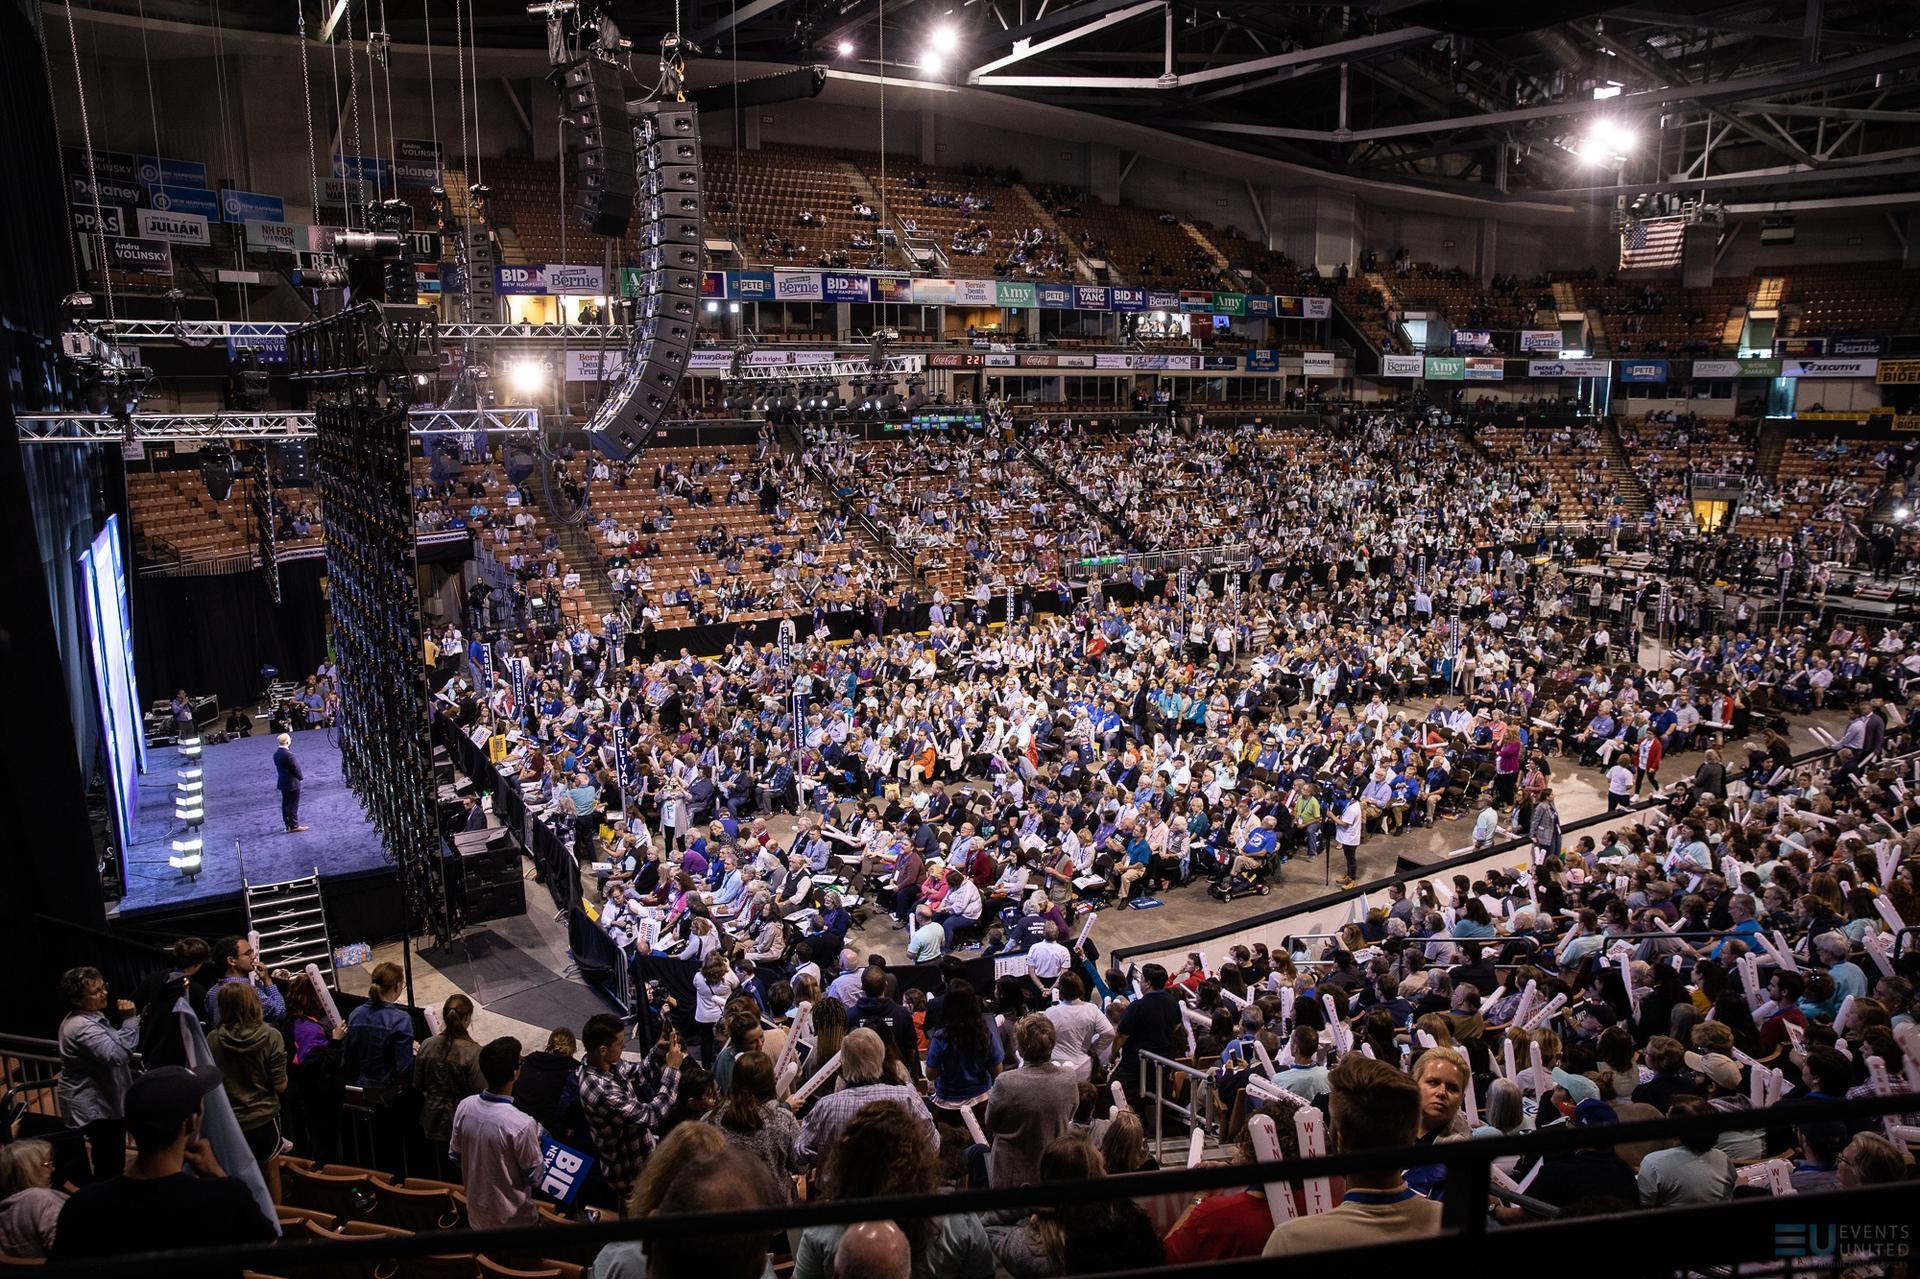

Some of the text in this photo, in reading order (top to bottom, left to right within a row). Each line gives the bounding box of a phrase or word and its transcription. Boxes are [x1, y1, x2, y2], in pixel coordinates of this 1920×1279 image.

[402, 149, 441, 158] VOLINSKY
[150, 221, 200, 236] JULIÁN
[262, 225, 294, 237] NH FOR
[115, 242, 140, 250] Andru
[116, 250, 168, 261] VOLINSKY
[551, 275, 600, 288] Bernie
[742, 281, 764, 291] PETE
[778, 280, 819, 294] Bernie
[827, 278, 864, 290] BIDEN
[1000, 286, 1031, 302] Amy
[1046, 292, 1064, 300] PETE
[1080, 293, 1105, 302] YANG
[1114, 290, 1142, 301] BIDEN
[1149, 295, 1179, 307] Bernie
[1216, 296, 1242, 308] Amy
[1253, 301, 1268, 309] PETE
[1524, 336, 1560, 348] Bernie
[1834, 342, 1880, 354] Bernie
[768, 356, 784, 364] right.
[1026, 356, 1049, 366] Coca-Cola
[1387, 362, 1420, 372] Bernie
[1430, 362, 1460, 374] Amy
[1634, 366, 1654, 375] PETE
[482, 646, 491, 681] NASHUA
[514, 660, 523, 704] ROCKINGHAM
[618, 730, 628, 786] SULLIVAN
[1264, 1124, 1280, 1159] WIN
[1304, 1122, 1316, 1158] WIN
[544, 1145, 558, 1168] NEW
[1770, 1168, 1784, 1194] WIN
